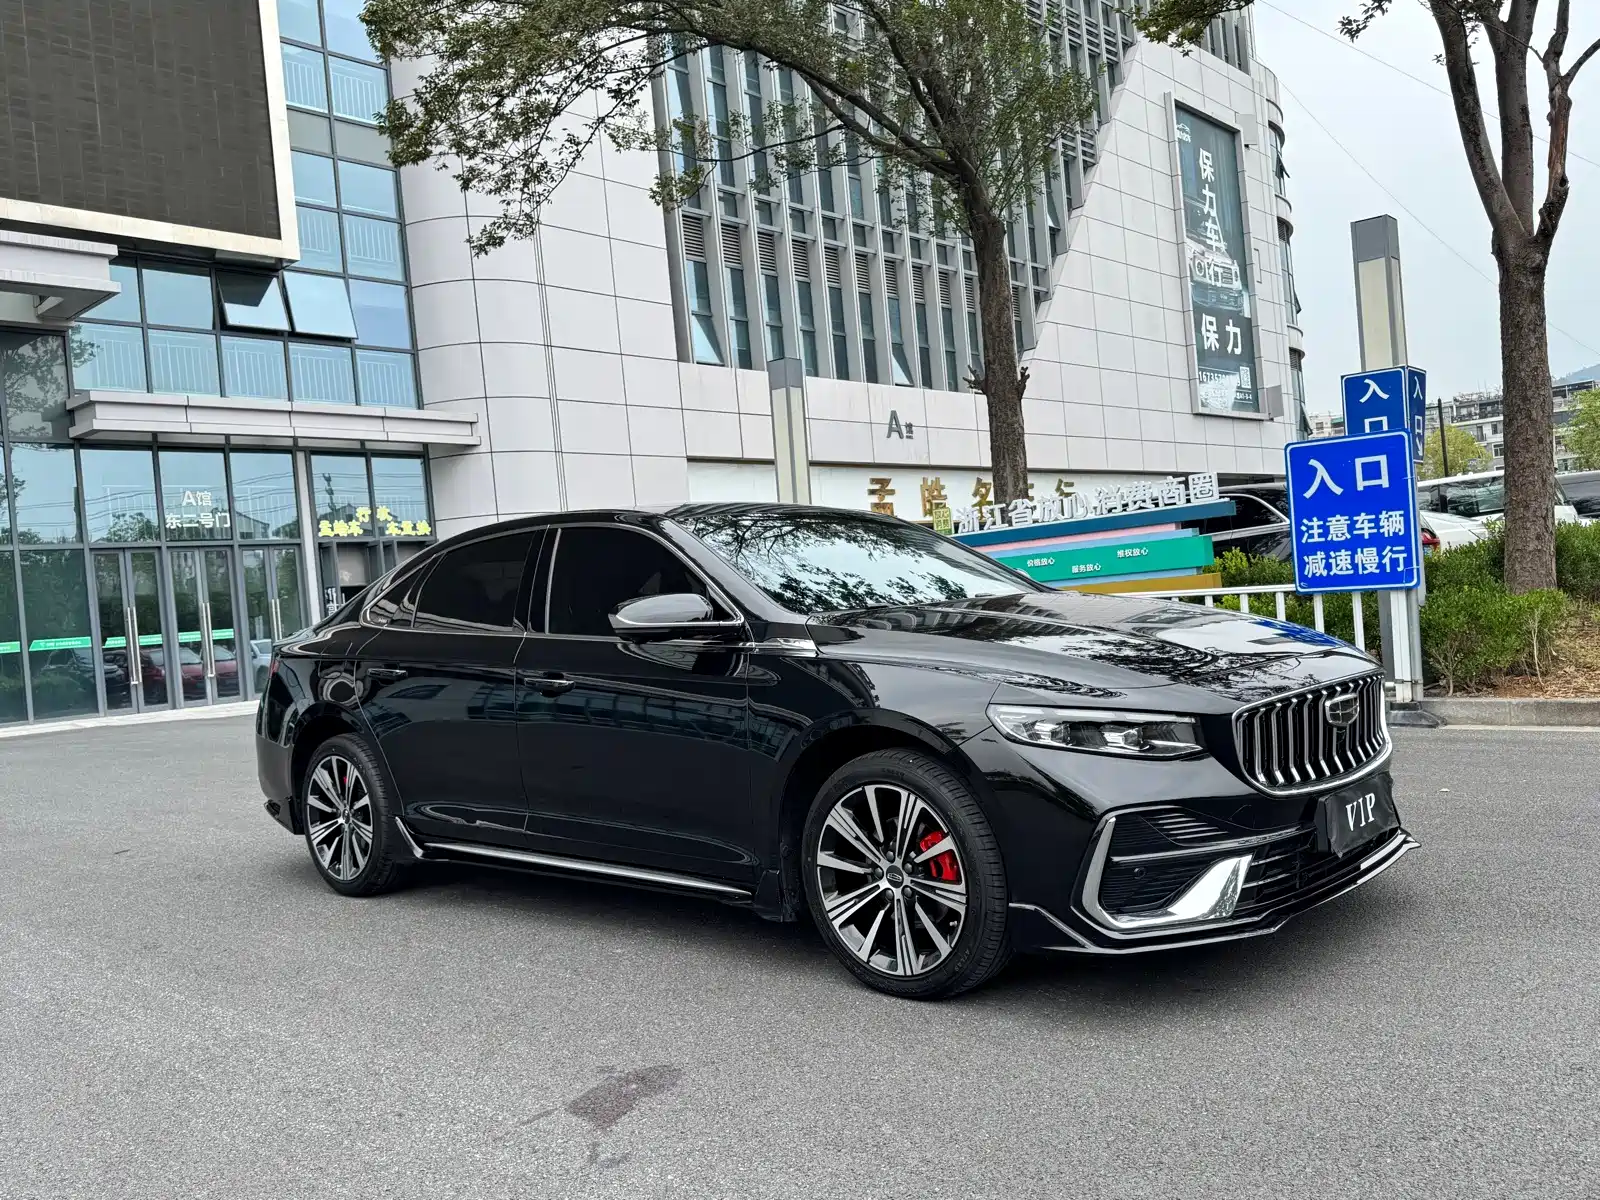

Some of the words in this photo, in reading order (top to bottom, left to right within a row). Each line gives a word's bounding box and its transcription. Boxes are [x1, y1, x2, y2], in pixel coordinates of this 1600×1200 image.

[1201, 312, 1242, 355] 保力
[1359, 378, 1390, 433] 入口
[1413, 375, 1424, 436] 入口
[1302, 454, 1390, 499] 入口
[181, 490, 212, 506] A馆
[954, 471, 1220, 534] 浙江省放心消费商圈
[165, 512, 231, 529] 东二号门
[1300, 510, 1405, 544] 注意车辆
[1072, 563, 1101, 574] 服务放心
[1117, 547, 1149, 558] 维权放心
[1303, 545, 1408, 578] 减速慢行
[1346, 793, 1375, 831] VIP
